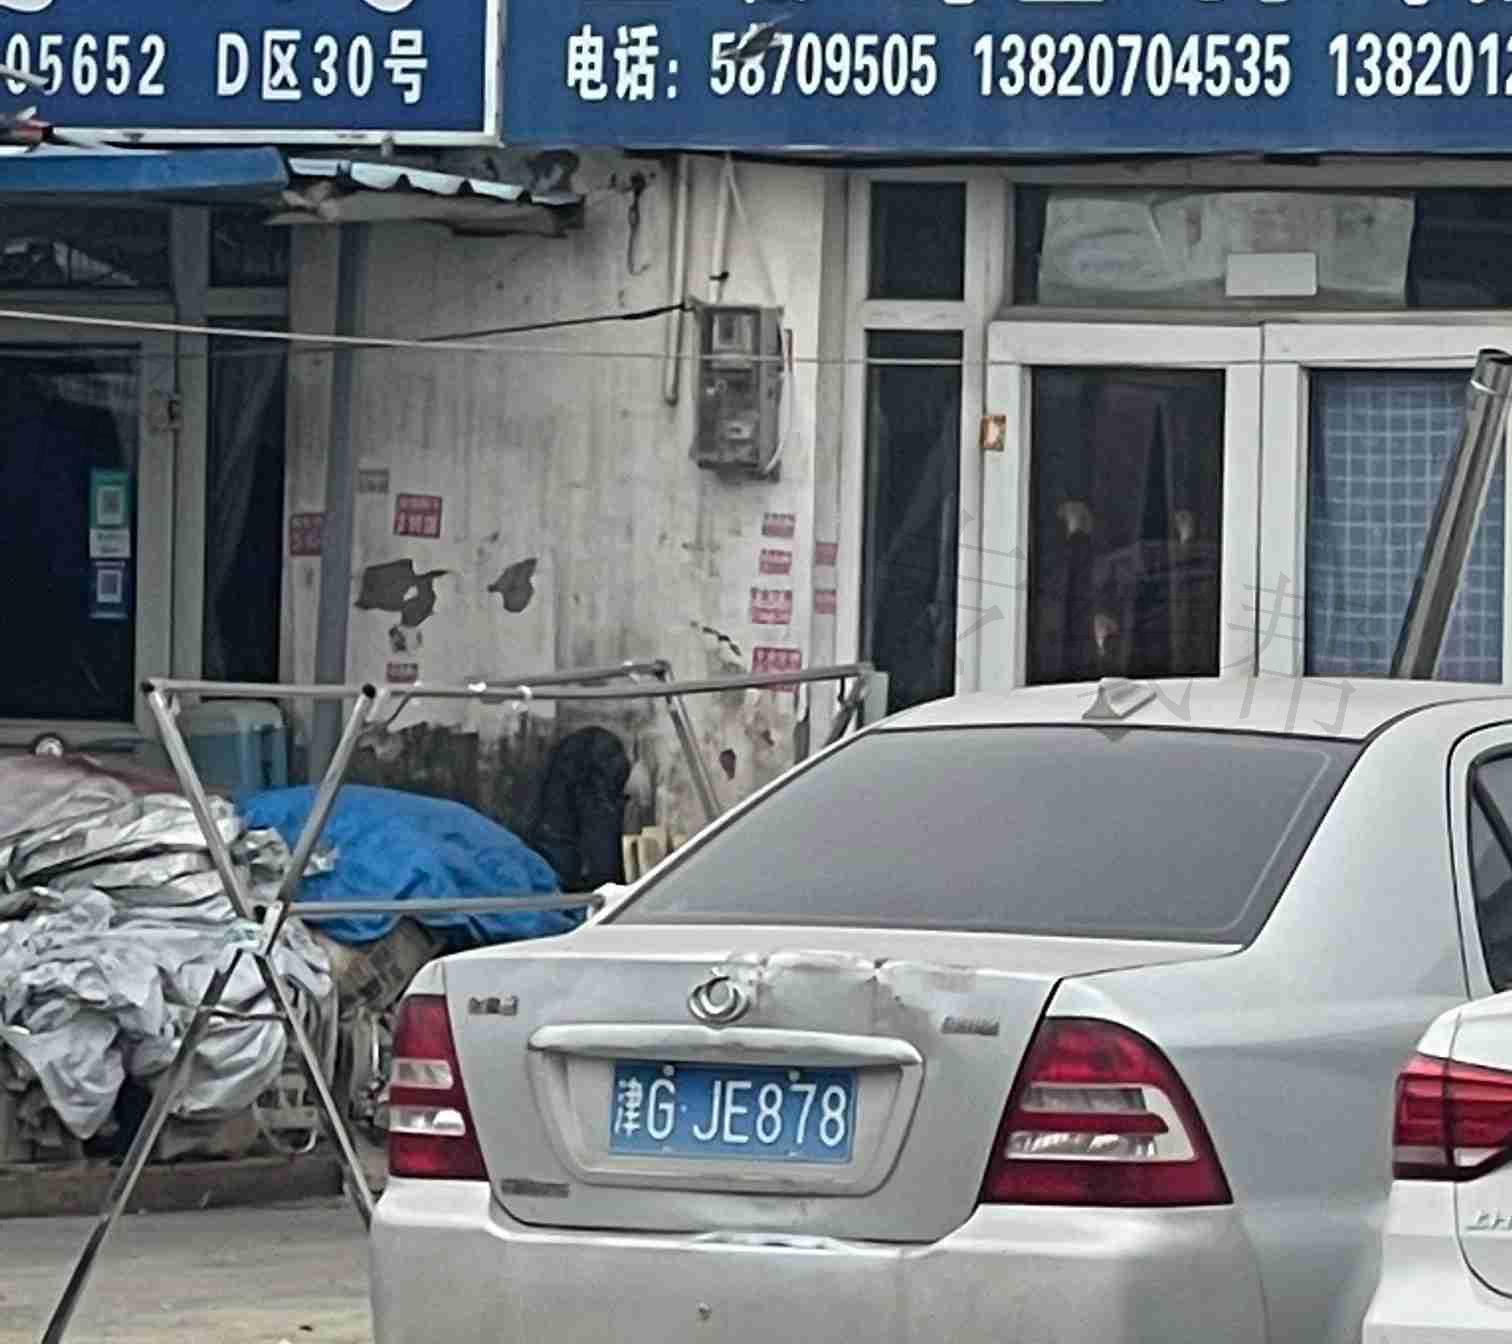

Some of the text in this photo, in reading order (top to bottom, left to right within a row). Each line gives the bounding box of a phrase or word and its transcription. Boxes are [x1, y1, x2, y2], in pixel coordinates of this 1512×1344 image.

[217, 30, 428, 103] D区30号
[567, 24, 679, 101] 电话：
[974, 33, 1290, 97] 13820704535
